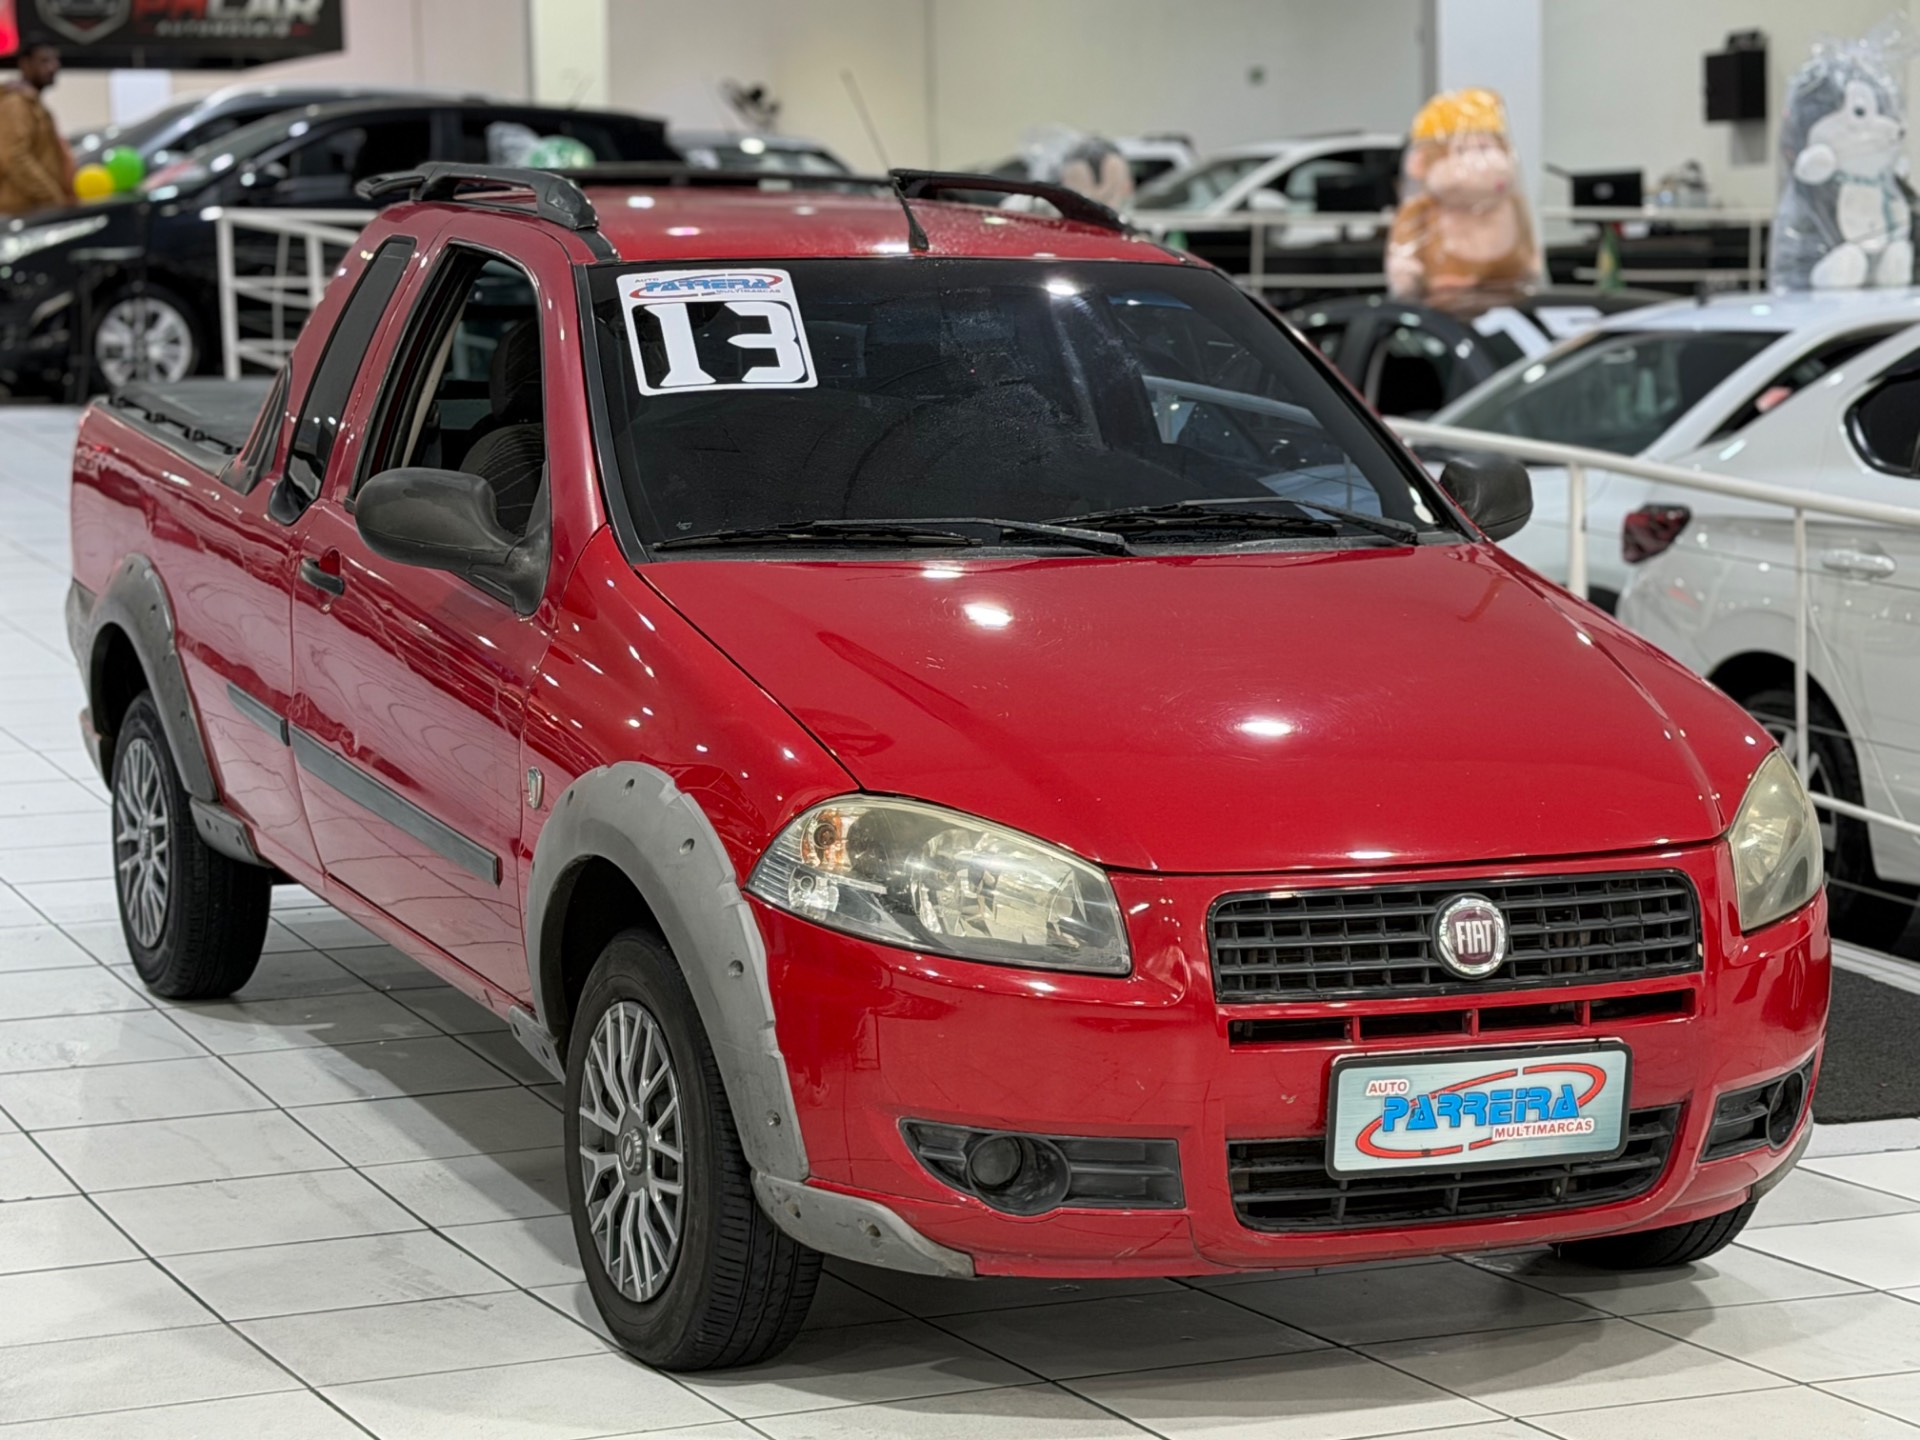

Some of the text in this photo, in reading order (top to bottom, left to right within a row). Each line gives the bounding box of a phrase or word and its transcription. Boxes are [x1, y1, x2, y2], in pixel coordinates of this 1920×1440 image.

[645, 278, 771, 293] PARREIRA
[643, 301, 806, 387] 13
[1455, 919, 1493, 955] FIAT
[1367, 1080, 1408, 1094] AUTO
[1381, 1083, 1580, 1132] PARREIRA
[1493, 1119, 1593, 1139] MULTIMARCAS
